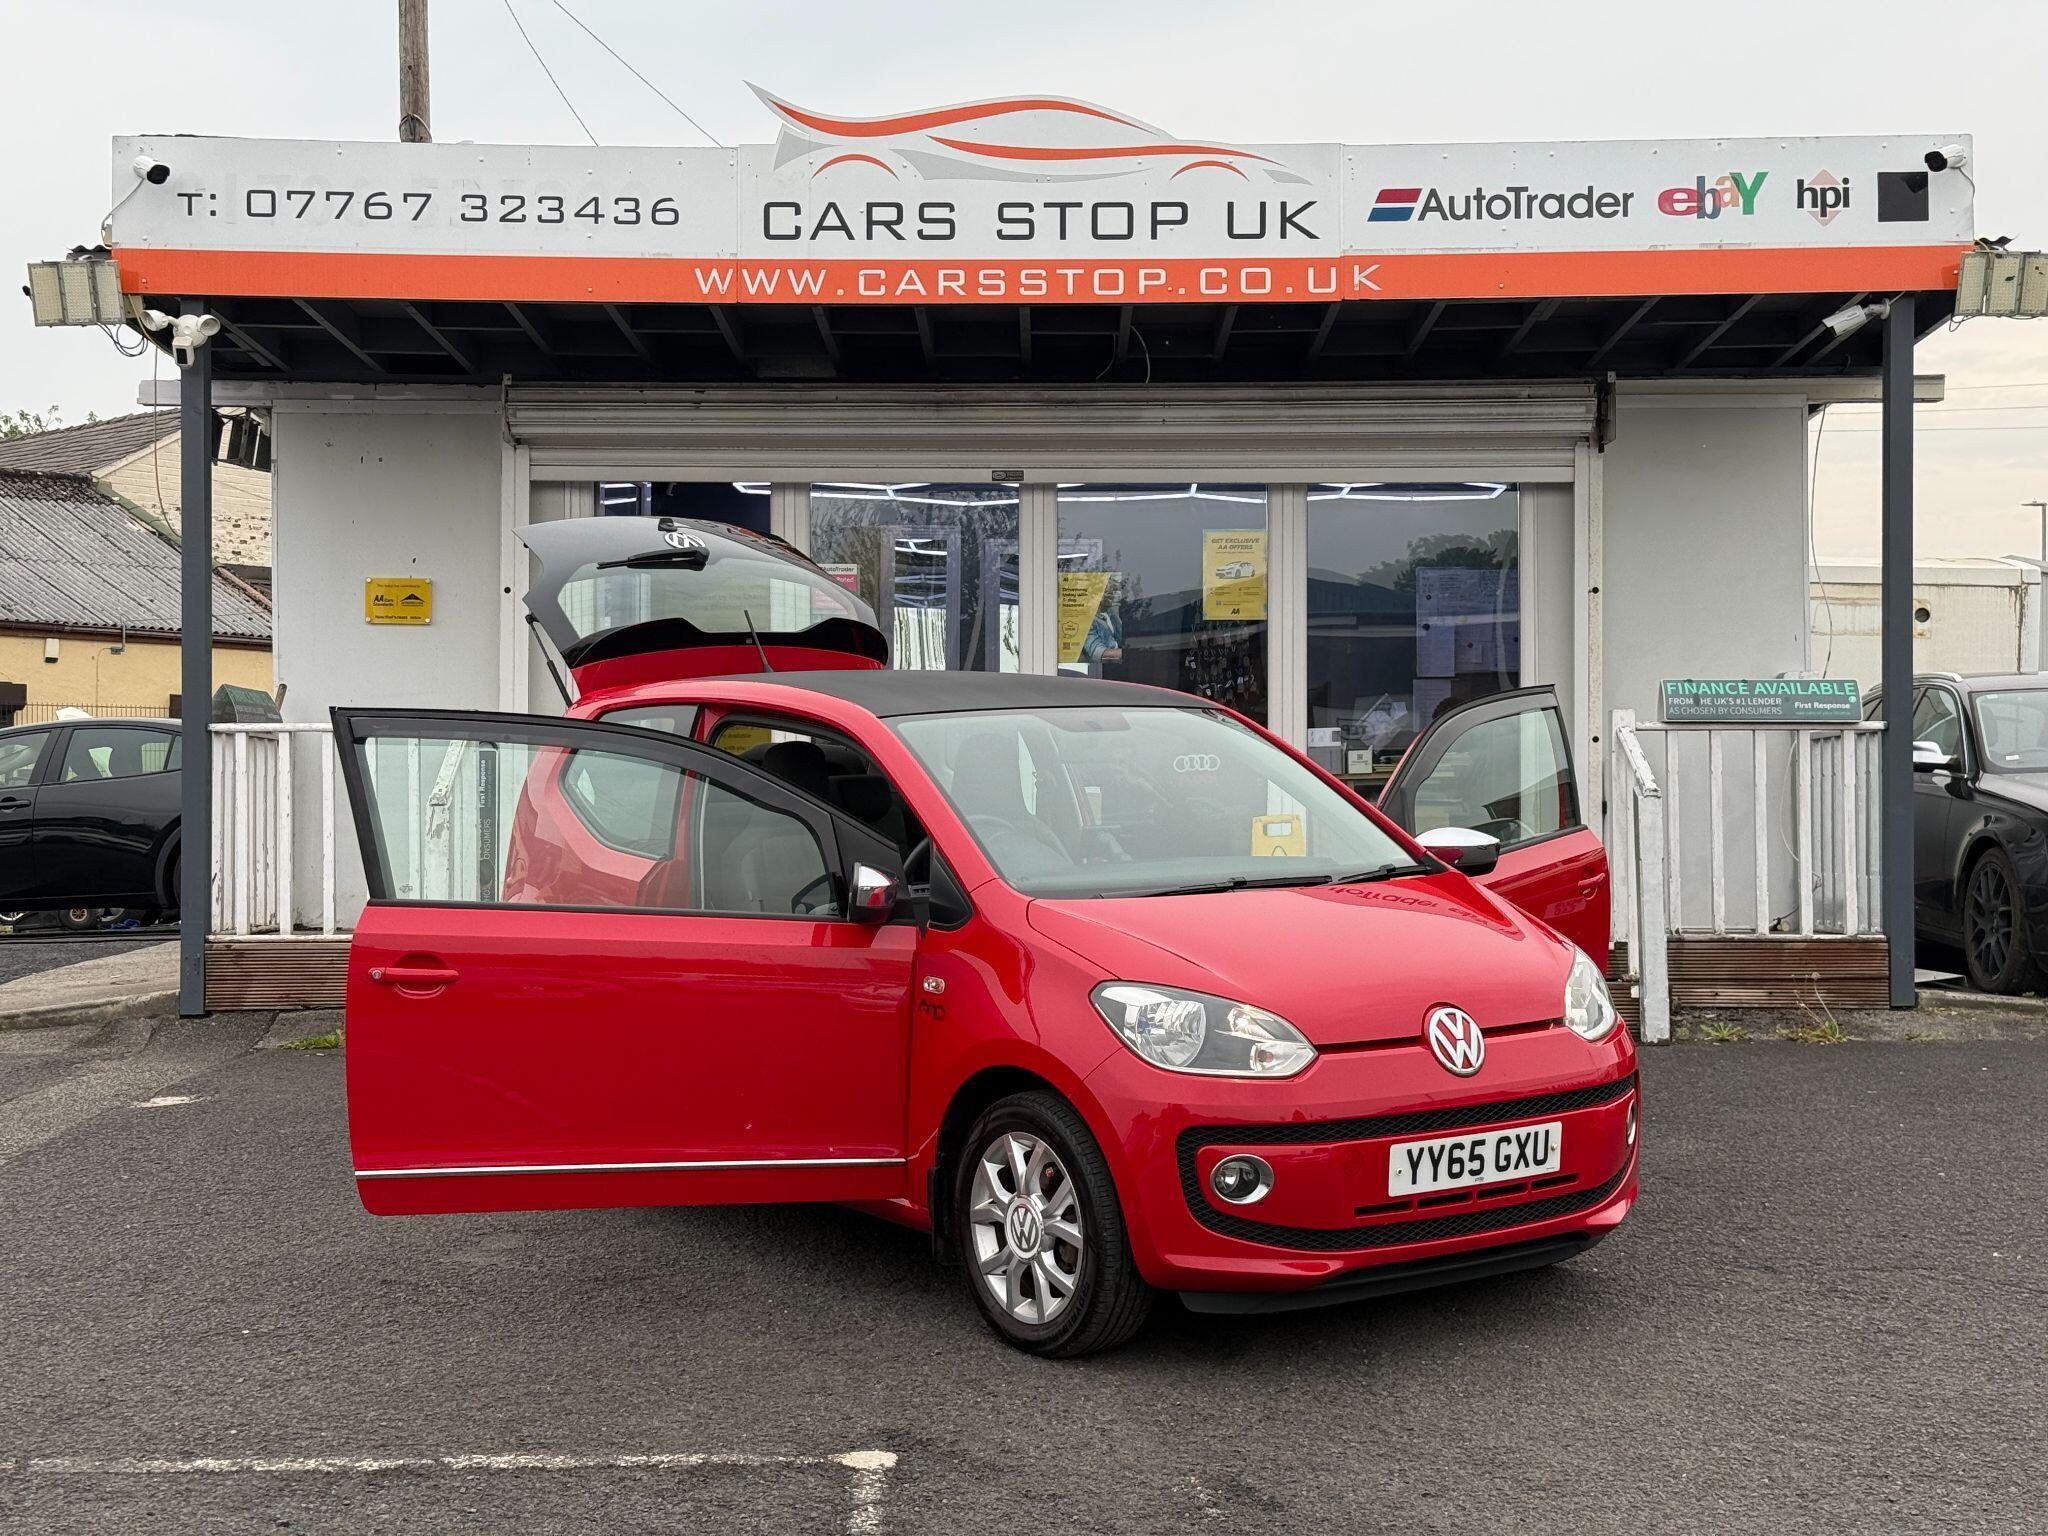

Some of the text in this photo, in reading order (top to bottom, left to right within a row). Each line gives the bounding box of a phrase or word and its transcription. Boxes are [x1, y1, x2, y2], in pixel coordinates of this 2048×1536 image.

[176, 189, 682, 227] T: 07767 323436
[1418, 186, 1634, 222] AutoTrader
[1796, 178, 1851, 218] hpi
[763, 201, 1321, 241] CARS STOP UK
[694, 264, 1383, 297] WWW.CARSSTOP.CO.UK
[1666, 682, 1856, 696] FINANCE AVAILABLE
[1795, 701, 1850, 710] First Response
[1680, 707, 1716, 715] CHOSEN
[1718, 707, 1728, 715] BY
[1730, 707, 1782, 715] CONSUMERS
[483, 818, 492, 861] ONSUMERS
[1406, 1128, 1550, 1186] YY65 GXU
